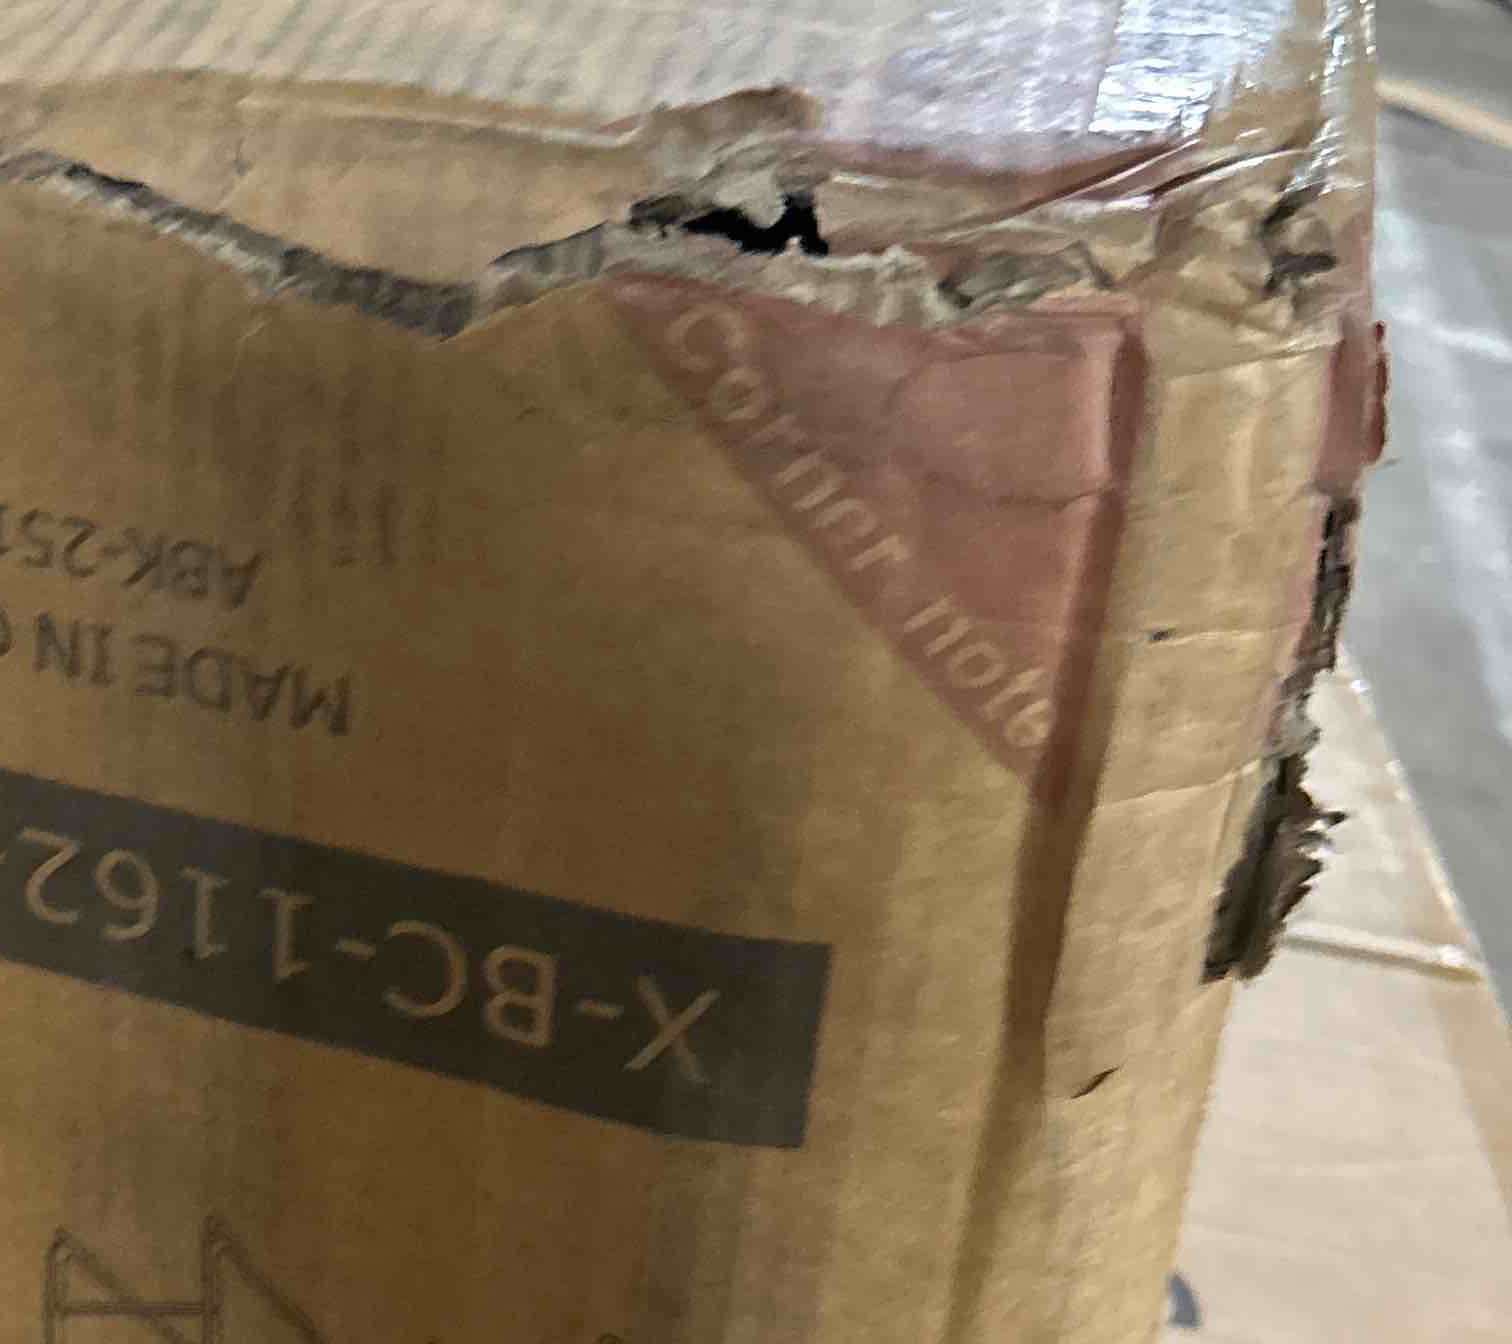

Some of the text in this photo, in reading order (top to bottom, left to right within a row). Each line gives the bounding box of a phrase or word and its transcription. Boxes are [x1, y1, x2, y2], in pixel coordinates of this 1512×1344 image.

[663, 300, 912, 573] Corner
[32, 609, 116, 687] IN
[132, 632, 353, 737] MADE
